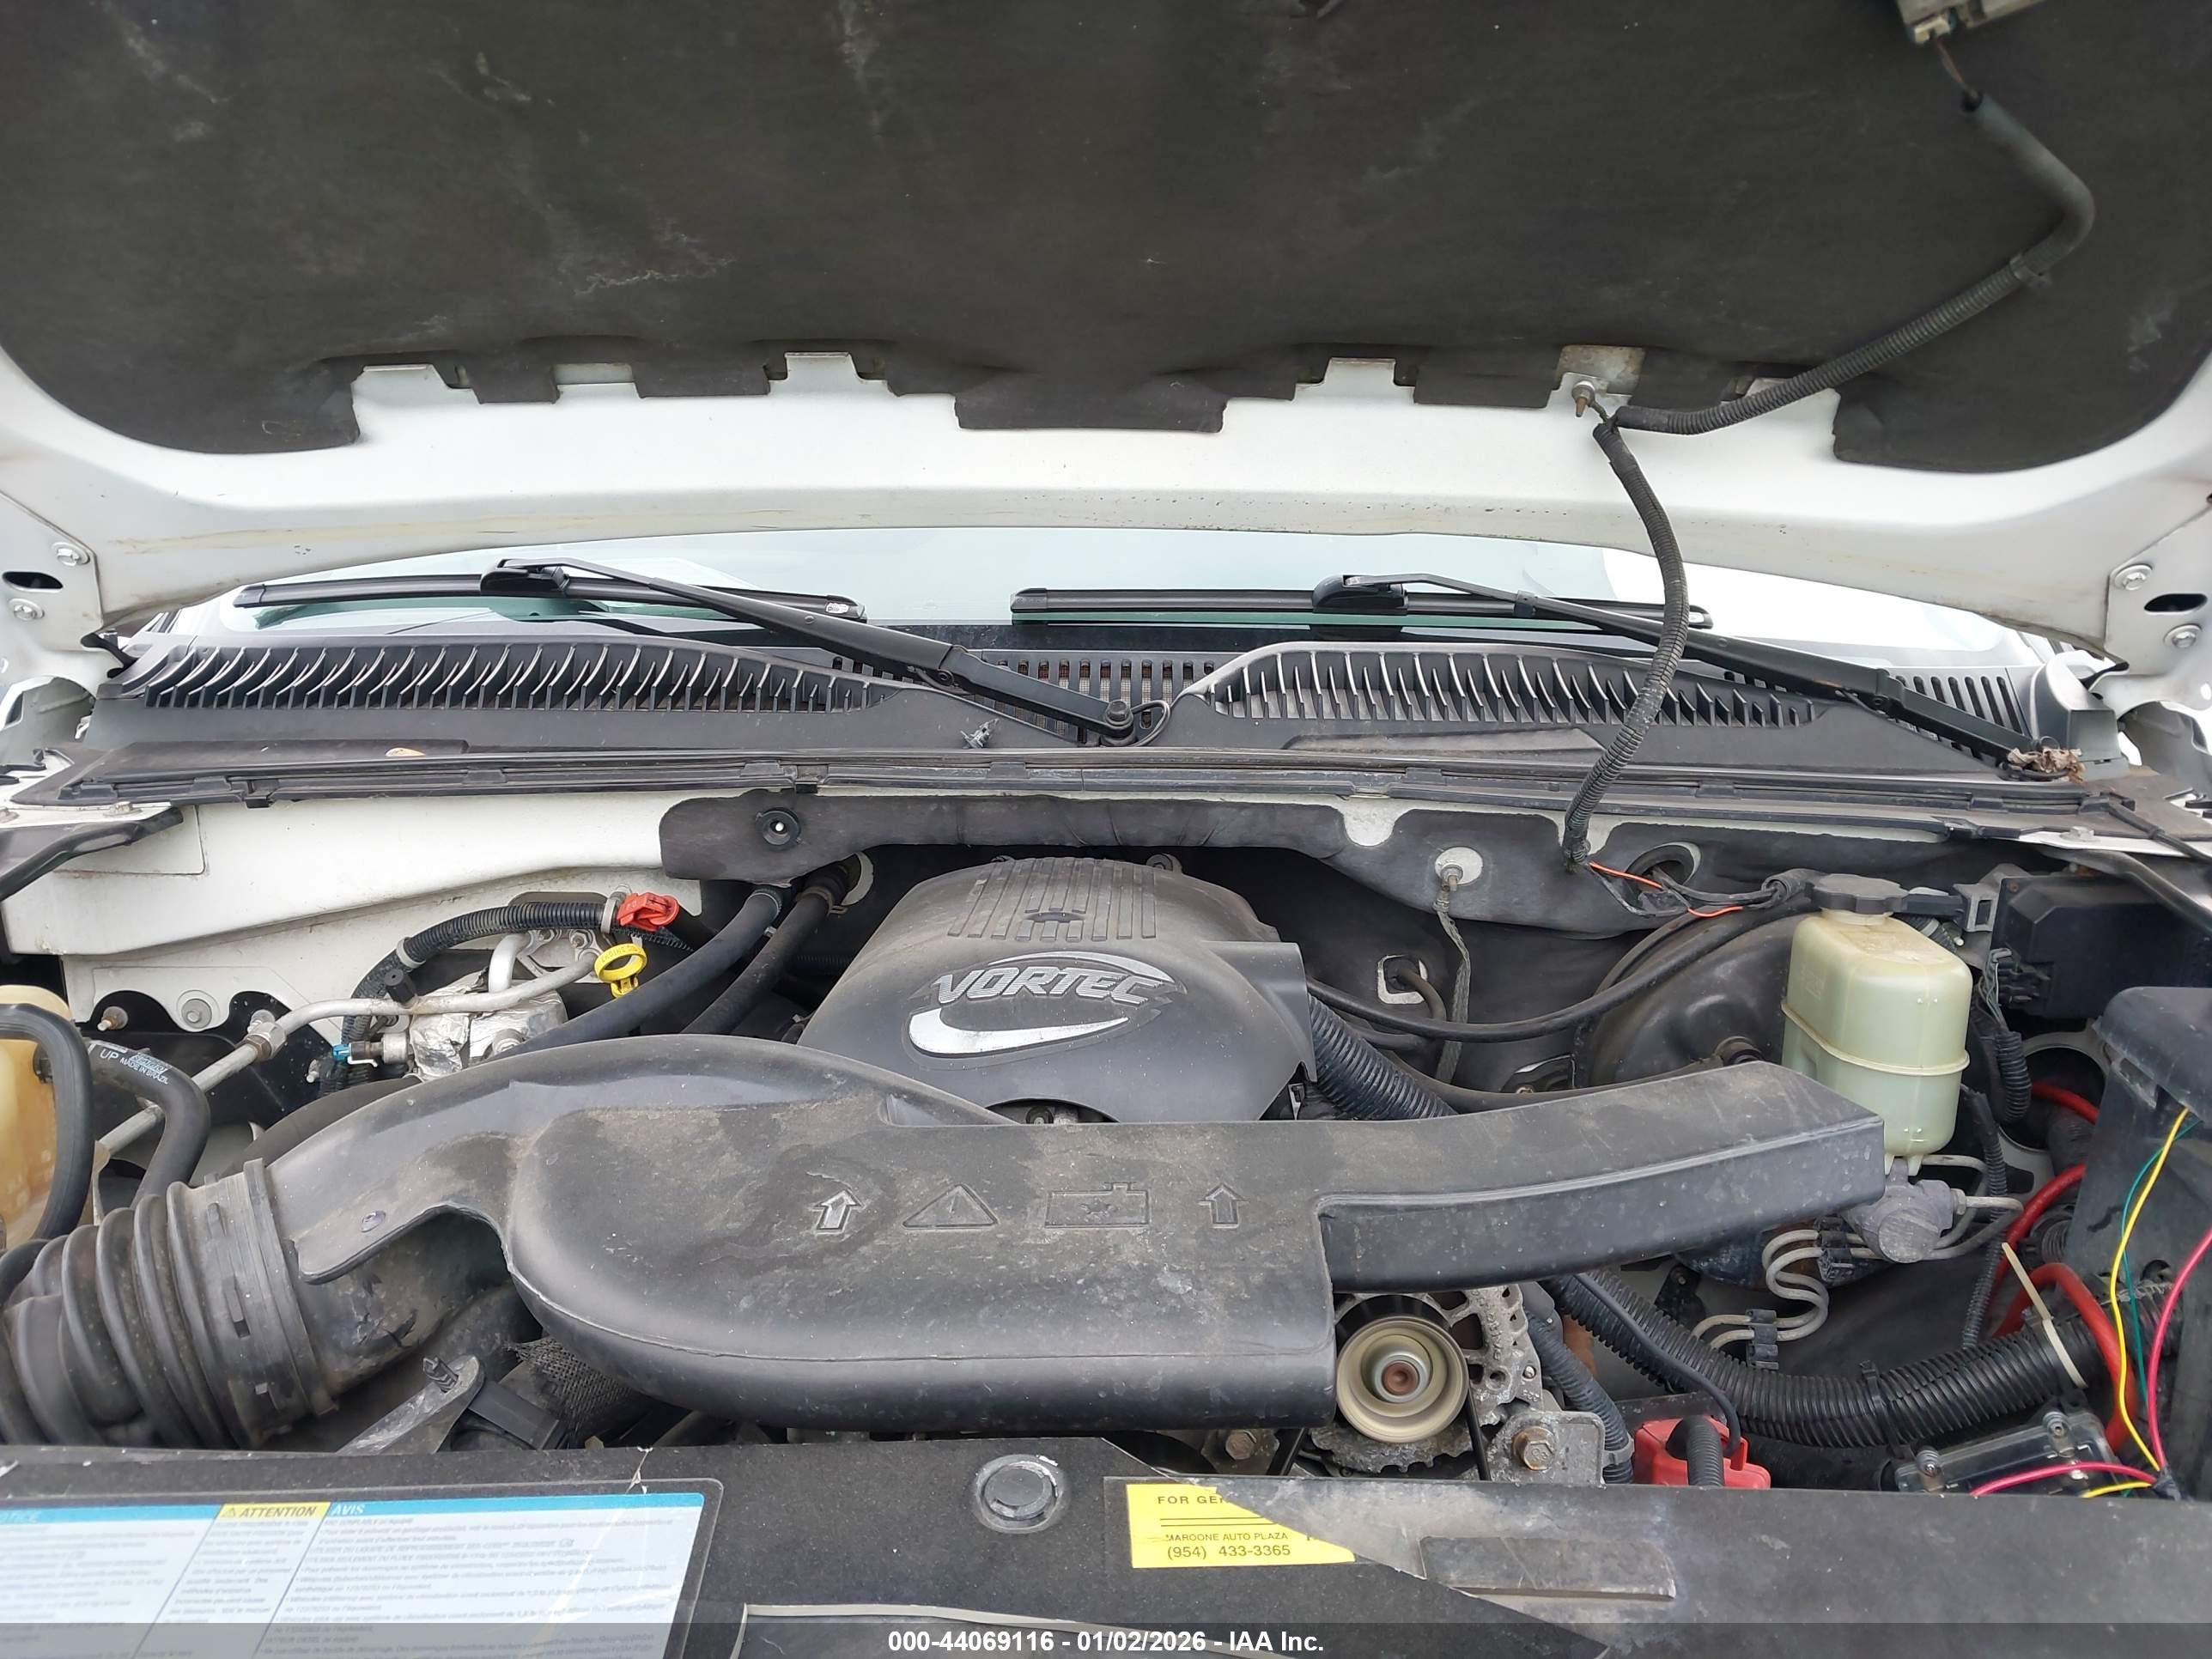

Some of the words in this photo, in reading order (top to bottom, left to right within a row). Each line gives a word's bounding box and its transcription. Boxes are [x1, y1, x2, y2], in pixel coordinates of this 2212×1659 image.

[932, 967, 1162, 1006] VORTEC
[100, 1048, 119, 1060] UP
[119, 1057, 138, 1071] MADE
[139, 1066, 147, 1076] IN
[146, 1070, 168, 1085] BRAZIL
[1158, 1496, 1189, 1504] FOR
[240, 1506, 317, 1518] ATTENTION
[331, 1504, 364, 1516] AVIS
[1165, 1533, 1219, 1541] MAROONE
[1223, 1533, 1251, 1541] AUTO
[1254, 1532, 1288, 1540] PLAZA
[1168, 1546, 1206, 1559] (954)
[1218, 1545, 1291, 1557] 433-3365
